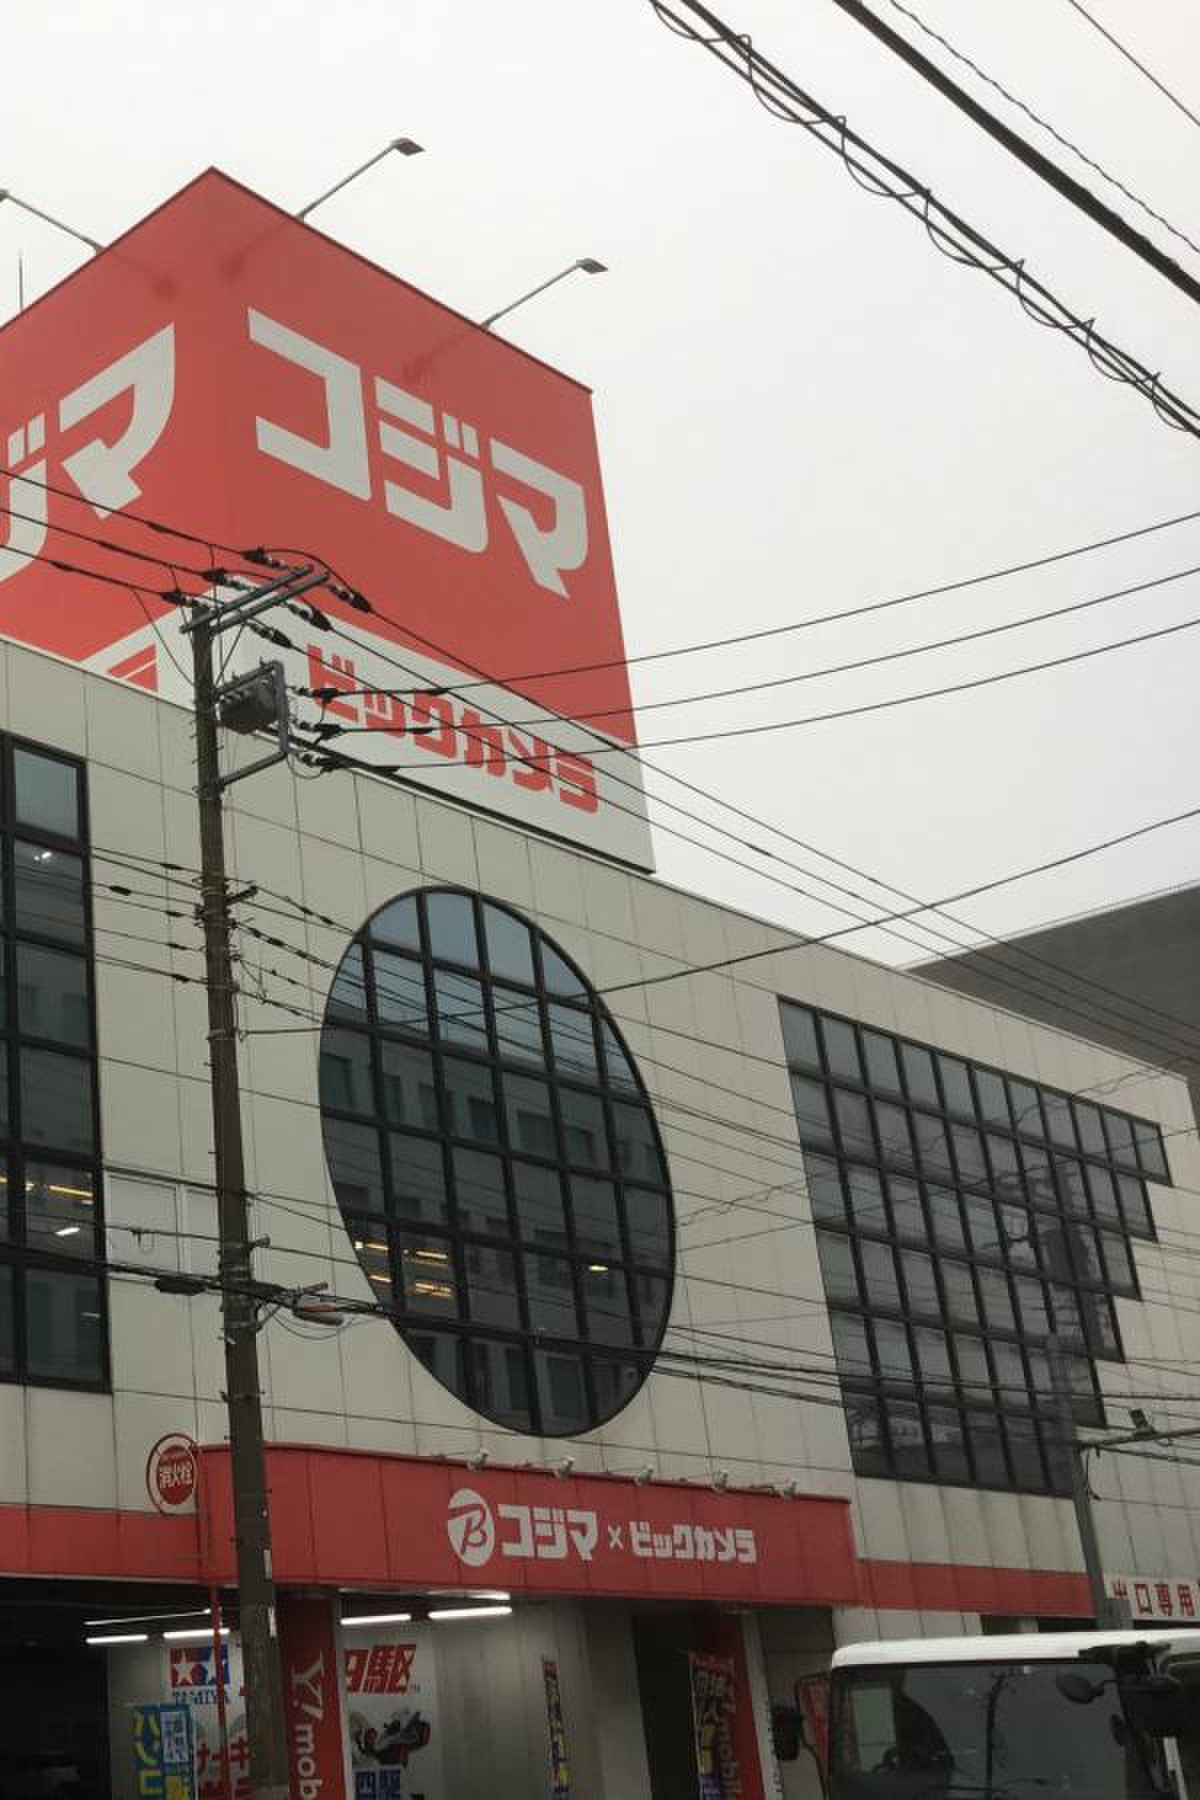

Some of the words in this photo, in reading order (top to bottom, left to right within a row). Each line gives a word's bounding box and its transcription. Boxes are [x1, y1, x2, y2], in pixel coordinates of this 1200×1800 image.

[247, 306, 589, 600] コジマ
[307, 643, 599, 814] ビックカメラ
[496, 1503, 599, 1561] コジマ
[628, 1520, 757, 1563] ビックカメラ
